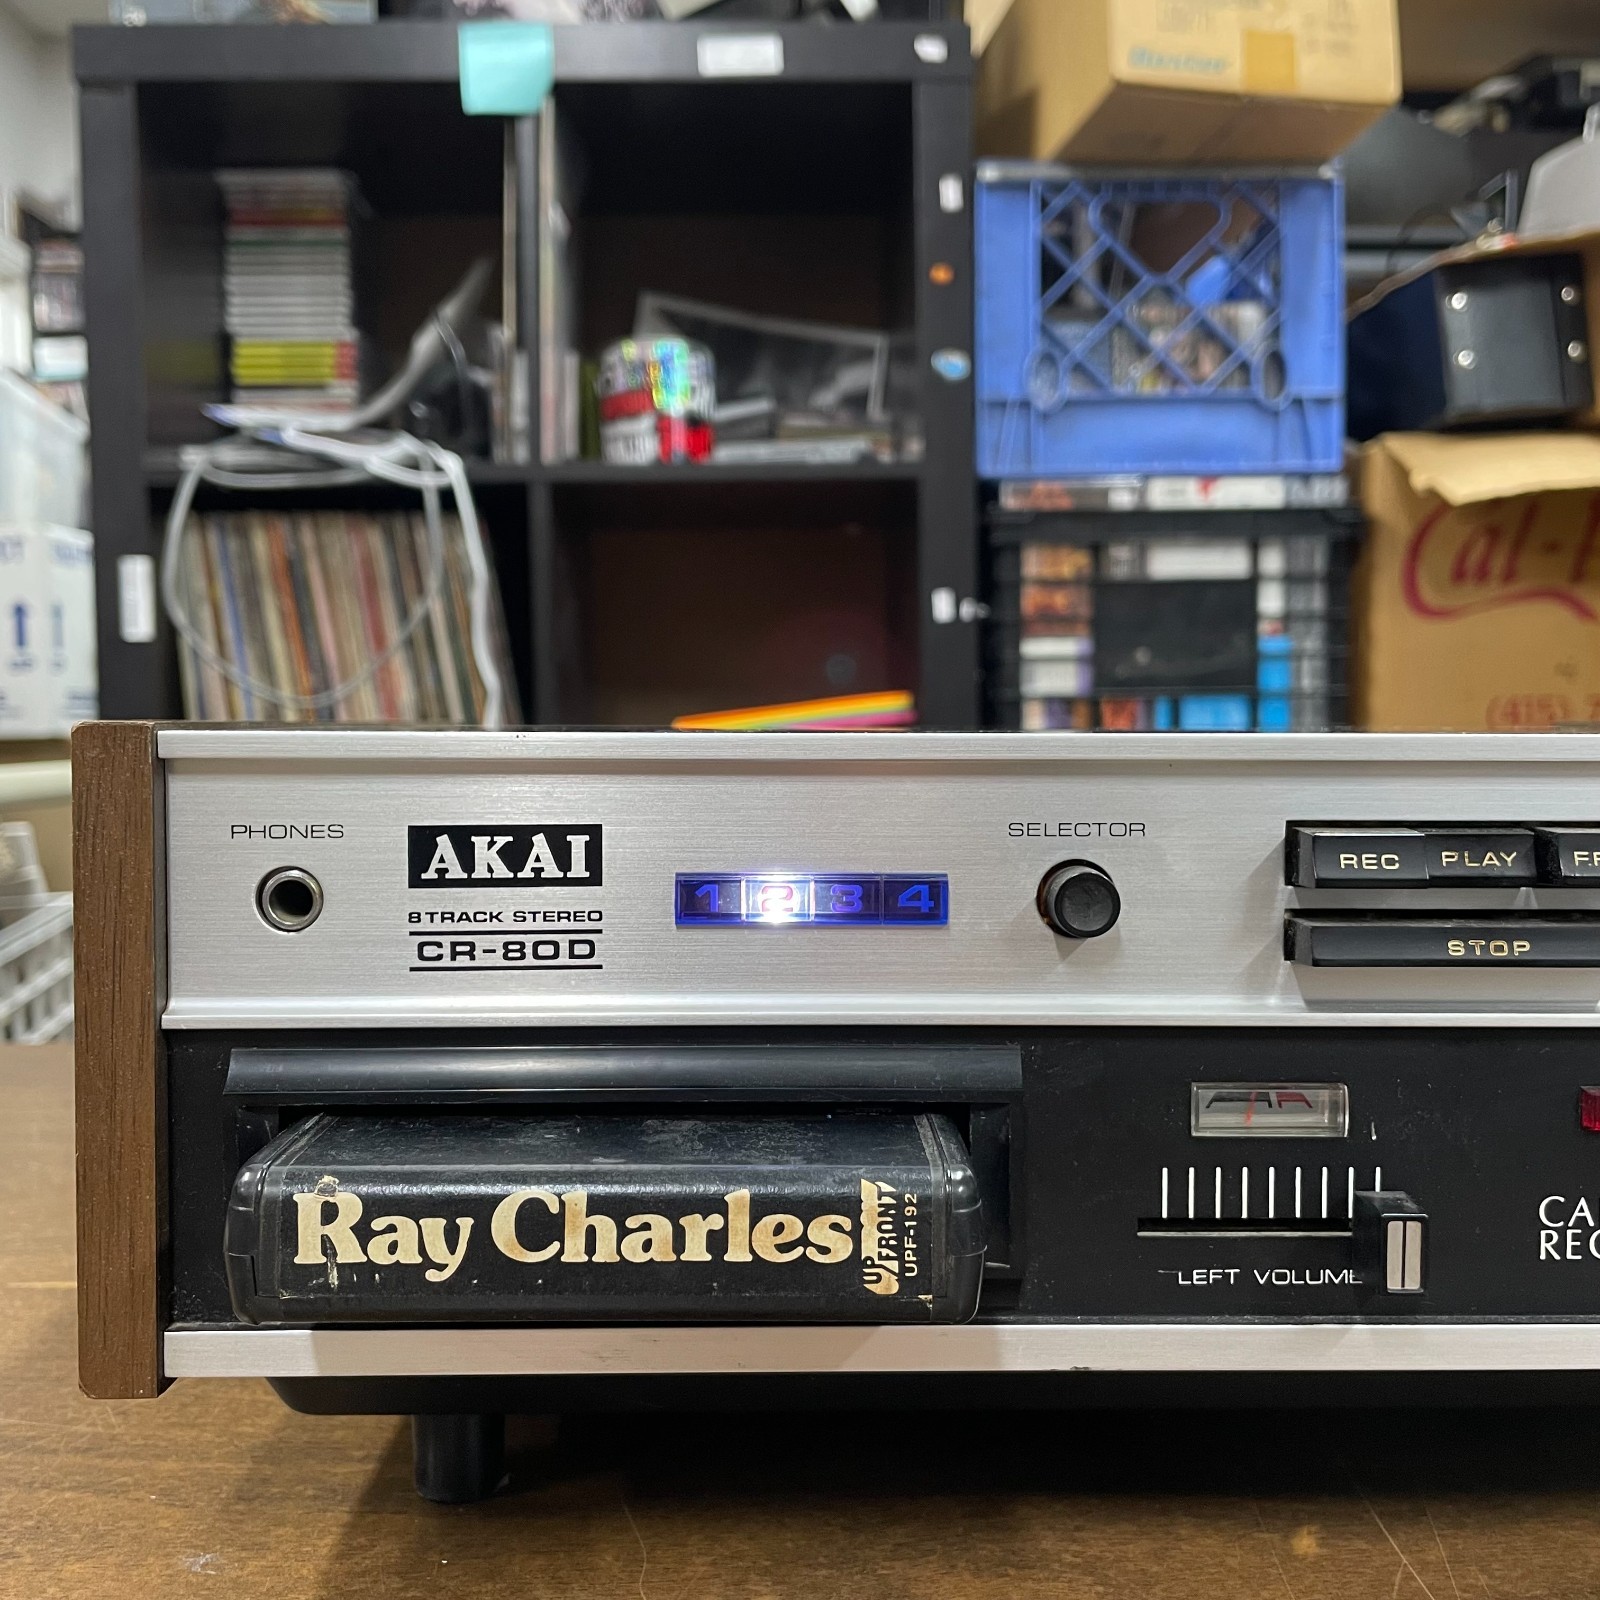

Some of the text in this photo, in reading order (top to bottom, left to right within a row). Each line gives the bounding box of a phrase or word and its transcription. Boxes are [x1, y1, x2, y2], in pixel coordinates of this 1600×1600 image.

[231, 824, 344, 839] PHONES
[1008, 822, 1146, 837] SELECTOR
[420, 832, 591, 880] AKAI
[1339, 853, 1400, 870] REC
[1441, 850, 1517, 867] PLAY
[695, 884, 934, 913] 1 2 3 4
[512, 910, 603, 923] STEREO
[417, 939, 596, 962] CR-80D
[1447, 939, 1531, 956] STOP
[293, 1188, 853, 1283] Ray Charles
[904, 1193, 918, 1277] UPF-192
[1178, 1268, 1240, 1285] LEFT
